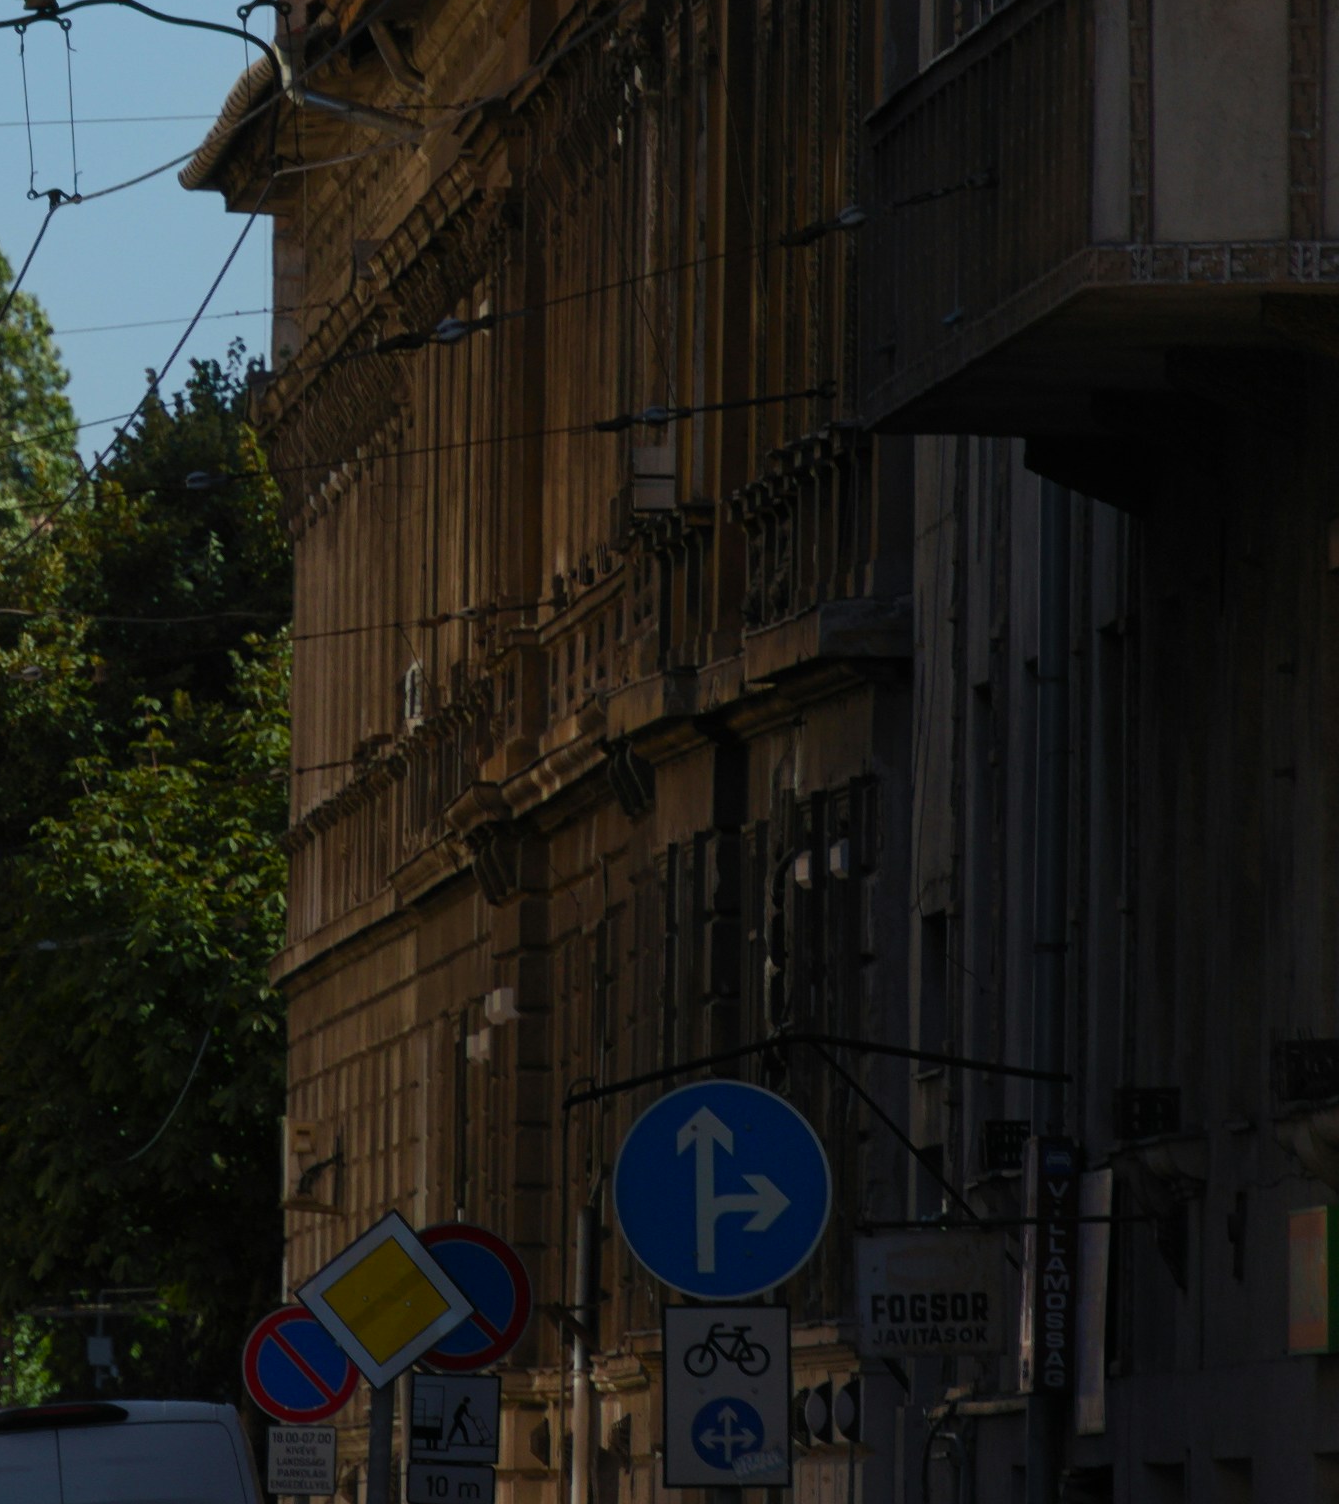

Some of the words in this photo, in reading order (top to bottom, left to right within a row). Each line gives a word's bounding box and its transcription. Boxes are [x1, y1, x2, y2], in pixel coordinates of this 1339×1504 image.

[871, 1293, 988, 1323] FOGSOR
[426, 1475, 448, 1498] 10
[458, 1482, 480, 1499] m
